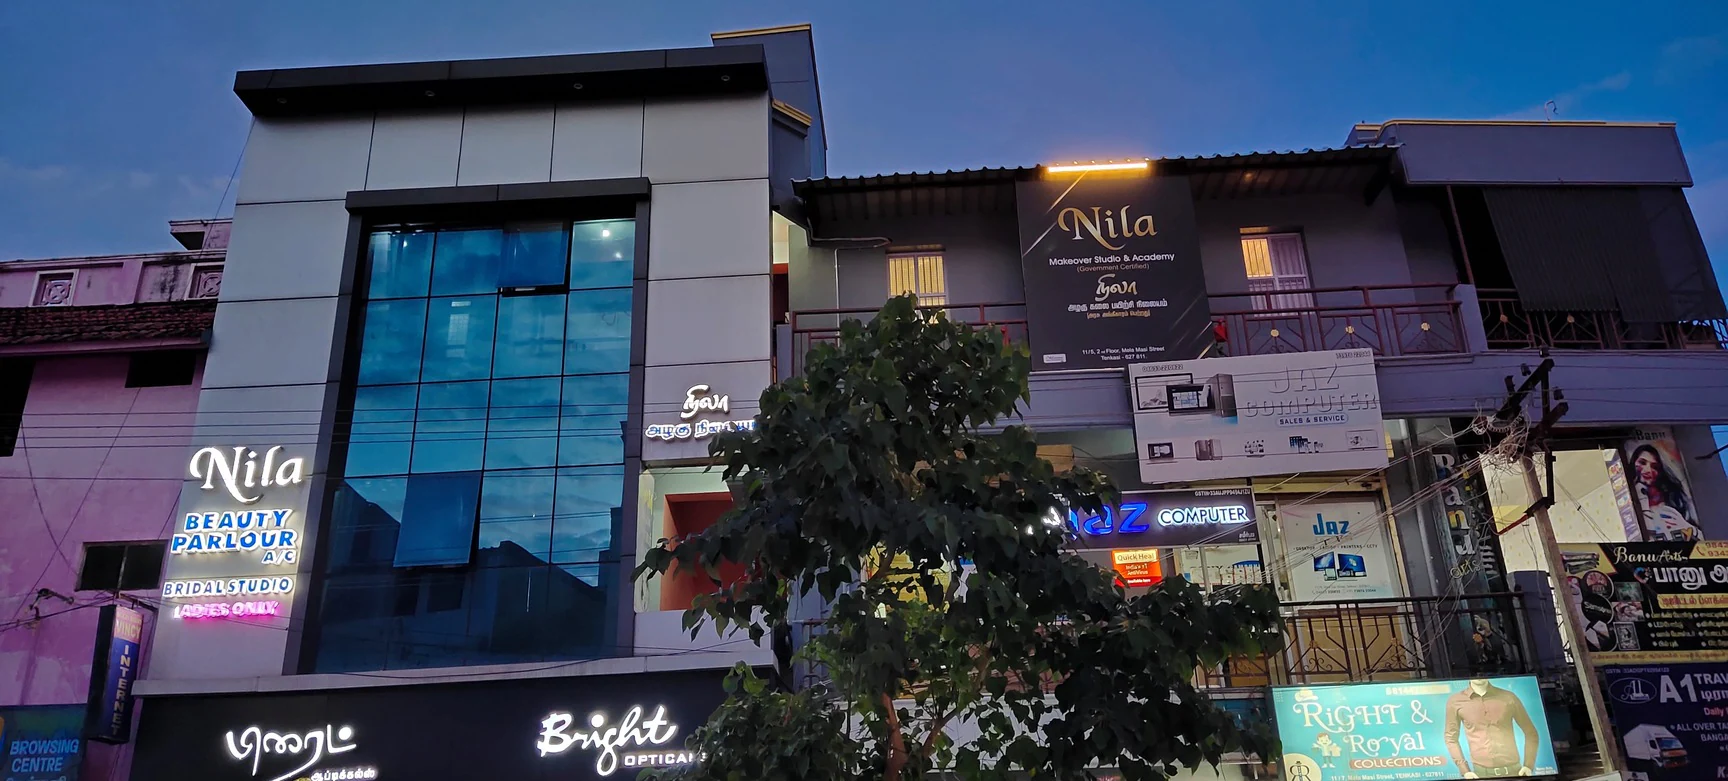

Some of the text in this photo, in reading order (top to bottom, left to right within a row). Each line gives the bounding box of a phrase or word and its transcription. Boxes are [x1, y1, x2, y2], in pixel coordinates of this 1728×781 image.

[1057, 205, 1157, 250] Nila
[1049, 258, 1092, 266] Makeover
[1094, 255, 1121, 264] Studio
[1132, 253, 1175, 262] Academy
[1076, 263, 1150, 273] (Government Certified)
[1095, 273, 1138, 302] நிலா
[1067, 303, 1088, 313] அழகு
[1089, 302, 1110, 310] கலை
[1136, 298, 1168, 308] நிலையம்
[1268, 362, 1340, 394] JAZ
[680, 384, 730, 419] நிலா
[1243, 393, 1378, 417] COMPUTER
[1314, 414, 1345, 423] SERVICE
[645, 423, 692, 440] அழகு
[189, 445, 304, 504] Nila
[184, 508, 293, 533] BEAUTY
[1157, 506, 1250, 526] COMPUTER
[171, 530, 298, 553] PARLOUR
[261, 550, 297, 565] A/C
[1117, 552, 1154, 562] Quick Heal
[1613, 547, 1659, 564] Banu
[162, 577, 293, 599] BRIDAL STUDIO
[1652, 567, 1708, 590] பானு
[173, 601, 280, 619] LADIES ONLY
[111, 644, 131, 736] INTERNET
[1659, 673, 1698, 703] A1
[1411, 699, 1433, 724] &
[1703, 707, 1724, 717] Daily
[1676, 723, 1692, 731] ALL
[1693, 722, 1715, 730] OVER
[10, 739, 79, 755] BROWSING
[537, 705, 678, 776] Bright
[1343, 731, 1426, 757] Royal
[225, 724, 357, 781] பிரைட்
[1353, 755, 1442, 769] COLLECTIONS
[11, 757, 63, 772] CENTRE
